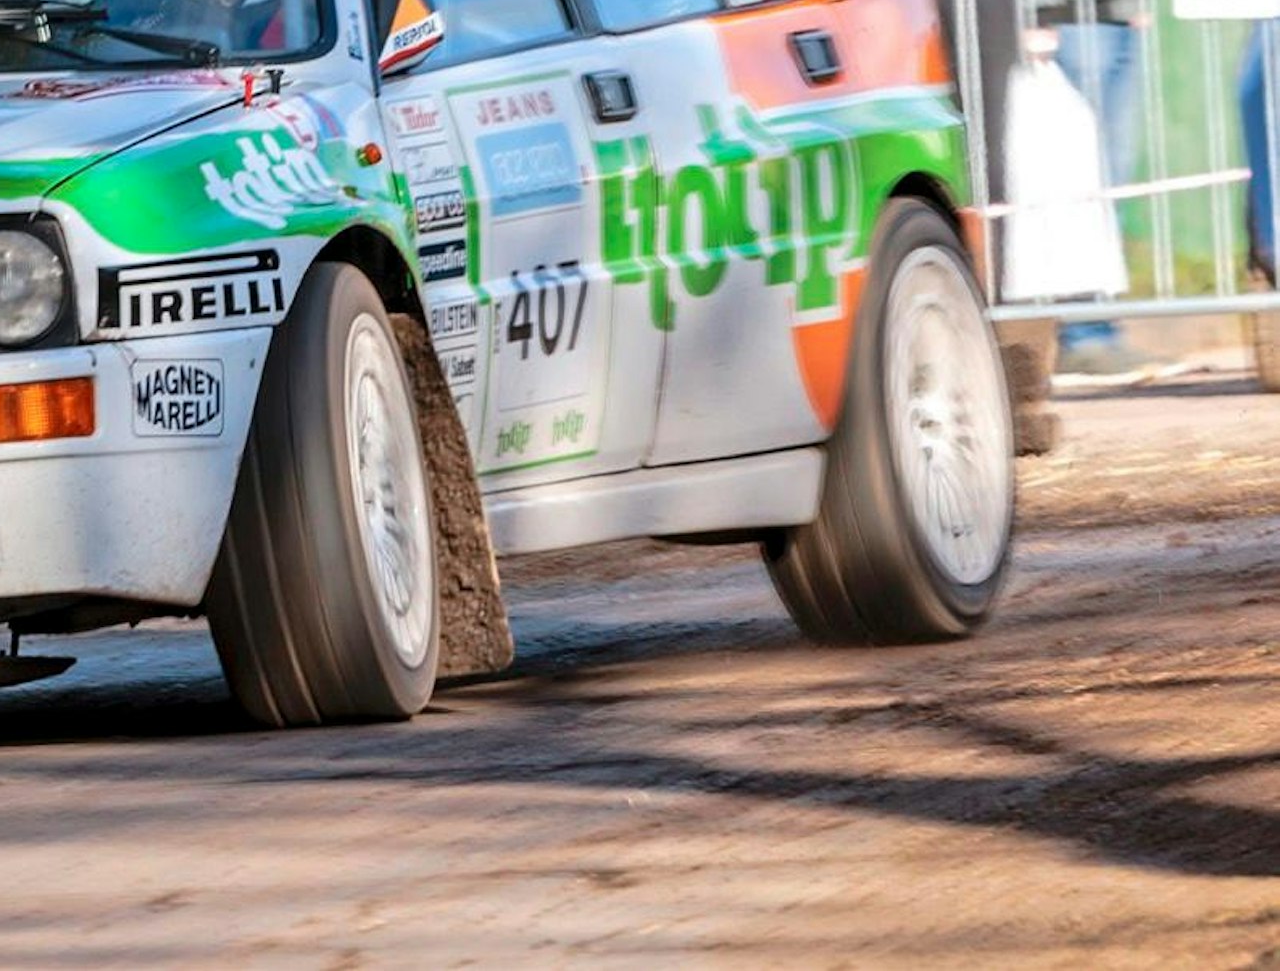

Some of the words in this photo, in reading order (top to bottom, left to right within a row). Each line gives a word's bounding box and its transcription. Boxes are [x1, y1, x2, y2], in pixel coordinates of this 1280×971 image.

[477, 90, 555, 126] JEANS
[98, 249, 285, 329] PIRELLI
[431, 303, 477, 335] BILSTEIN
[507, 261, 589, 360] 407
[137, 366, 220, 400] MAGNETI
[137, 392, 220, 430] MARELLI
